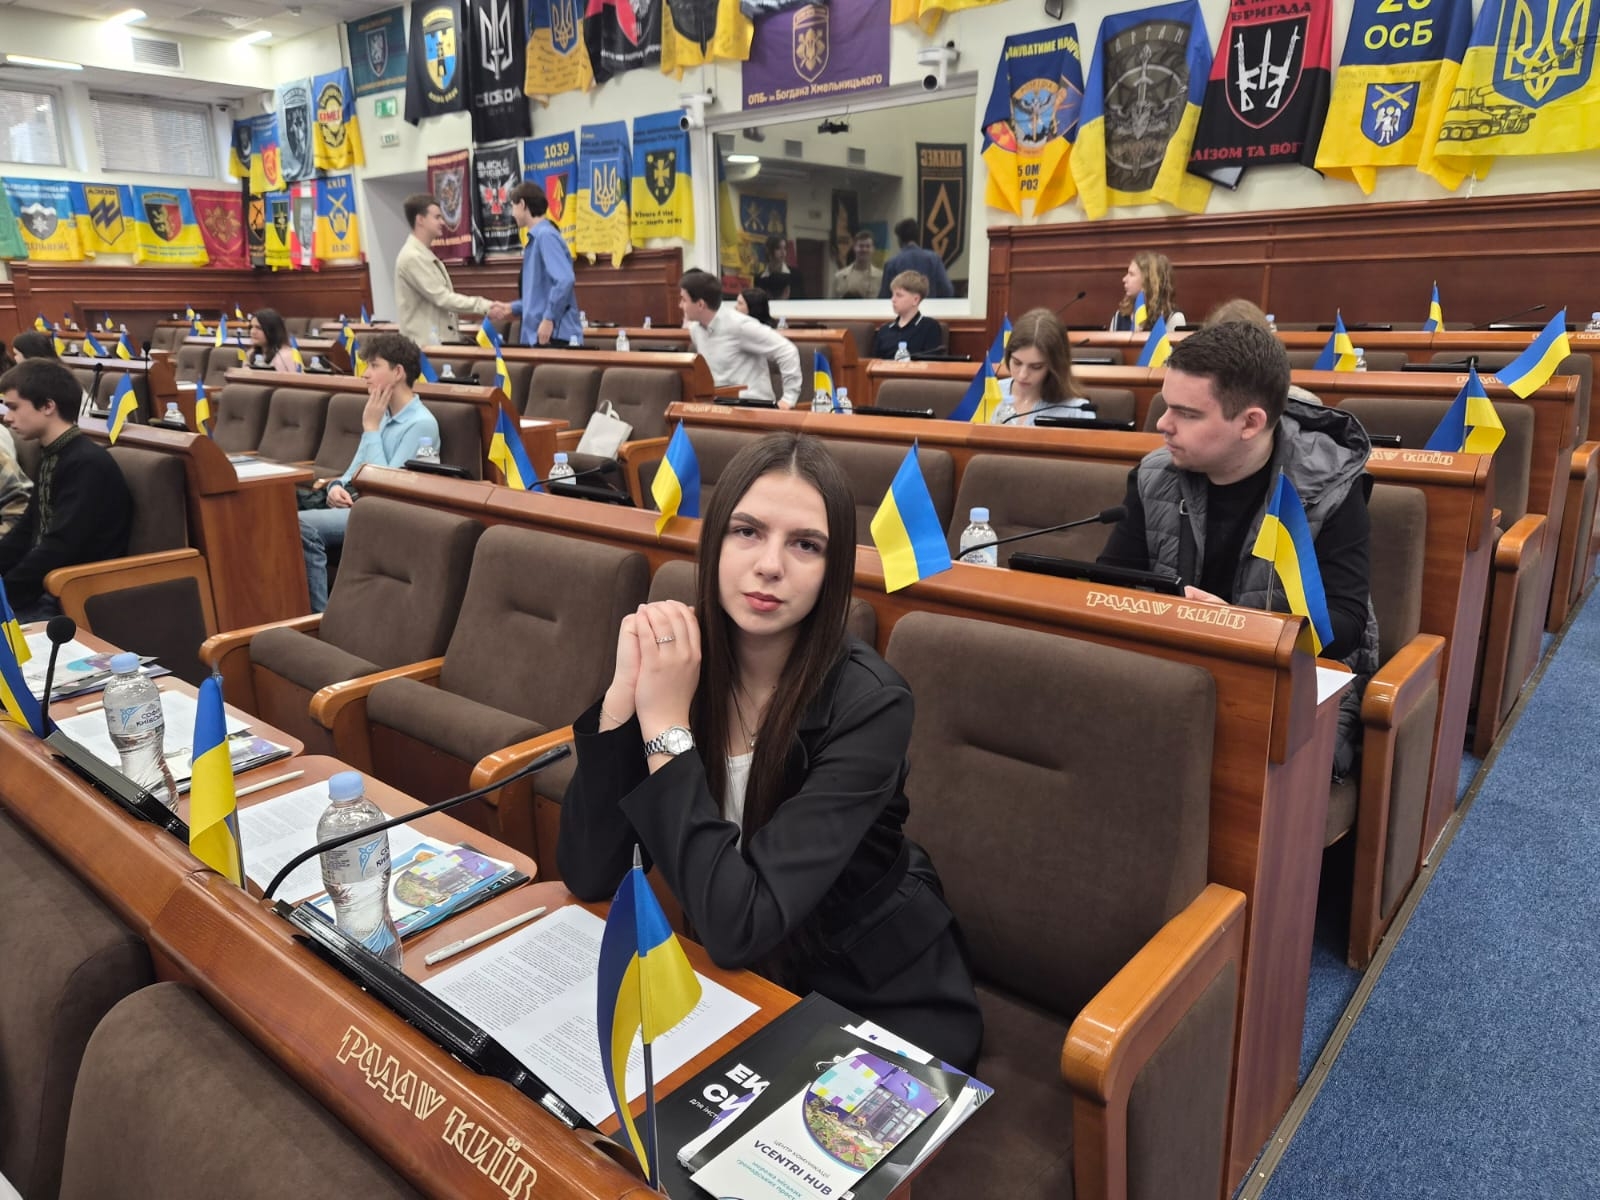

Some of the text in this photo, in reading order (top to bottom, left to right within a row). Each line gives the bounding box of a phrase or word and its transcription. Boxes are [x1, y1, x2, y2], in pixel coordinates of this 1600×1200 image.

[1231, 2, 1312, 21] БРИГАДА
[1364, 19, 1433, 50] ОСБ
[776, 86, 810, 100] Богдана
[810, 73, 883, 95] Хмельницького
[544, 141, 570, 159] 1039
[1246, 145, 1266, 158] ТА
[1176, 605, 1247, 630] КИЇВ
[441, 1106, 538, 1200] КИЇВ
[753, 1139, 833, 1196] VCENTRI HUB
